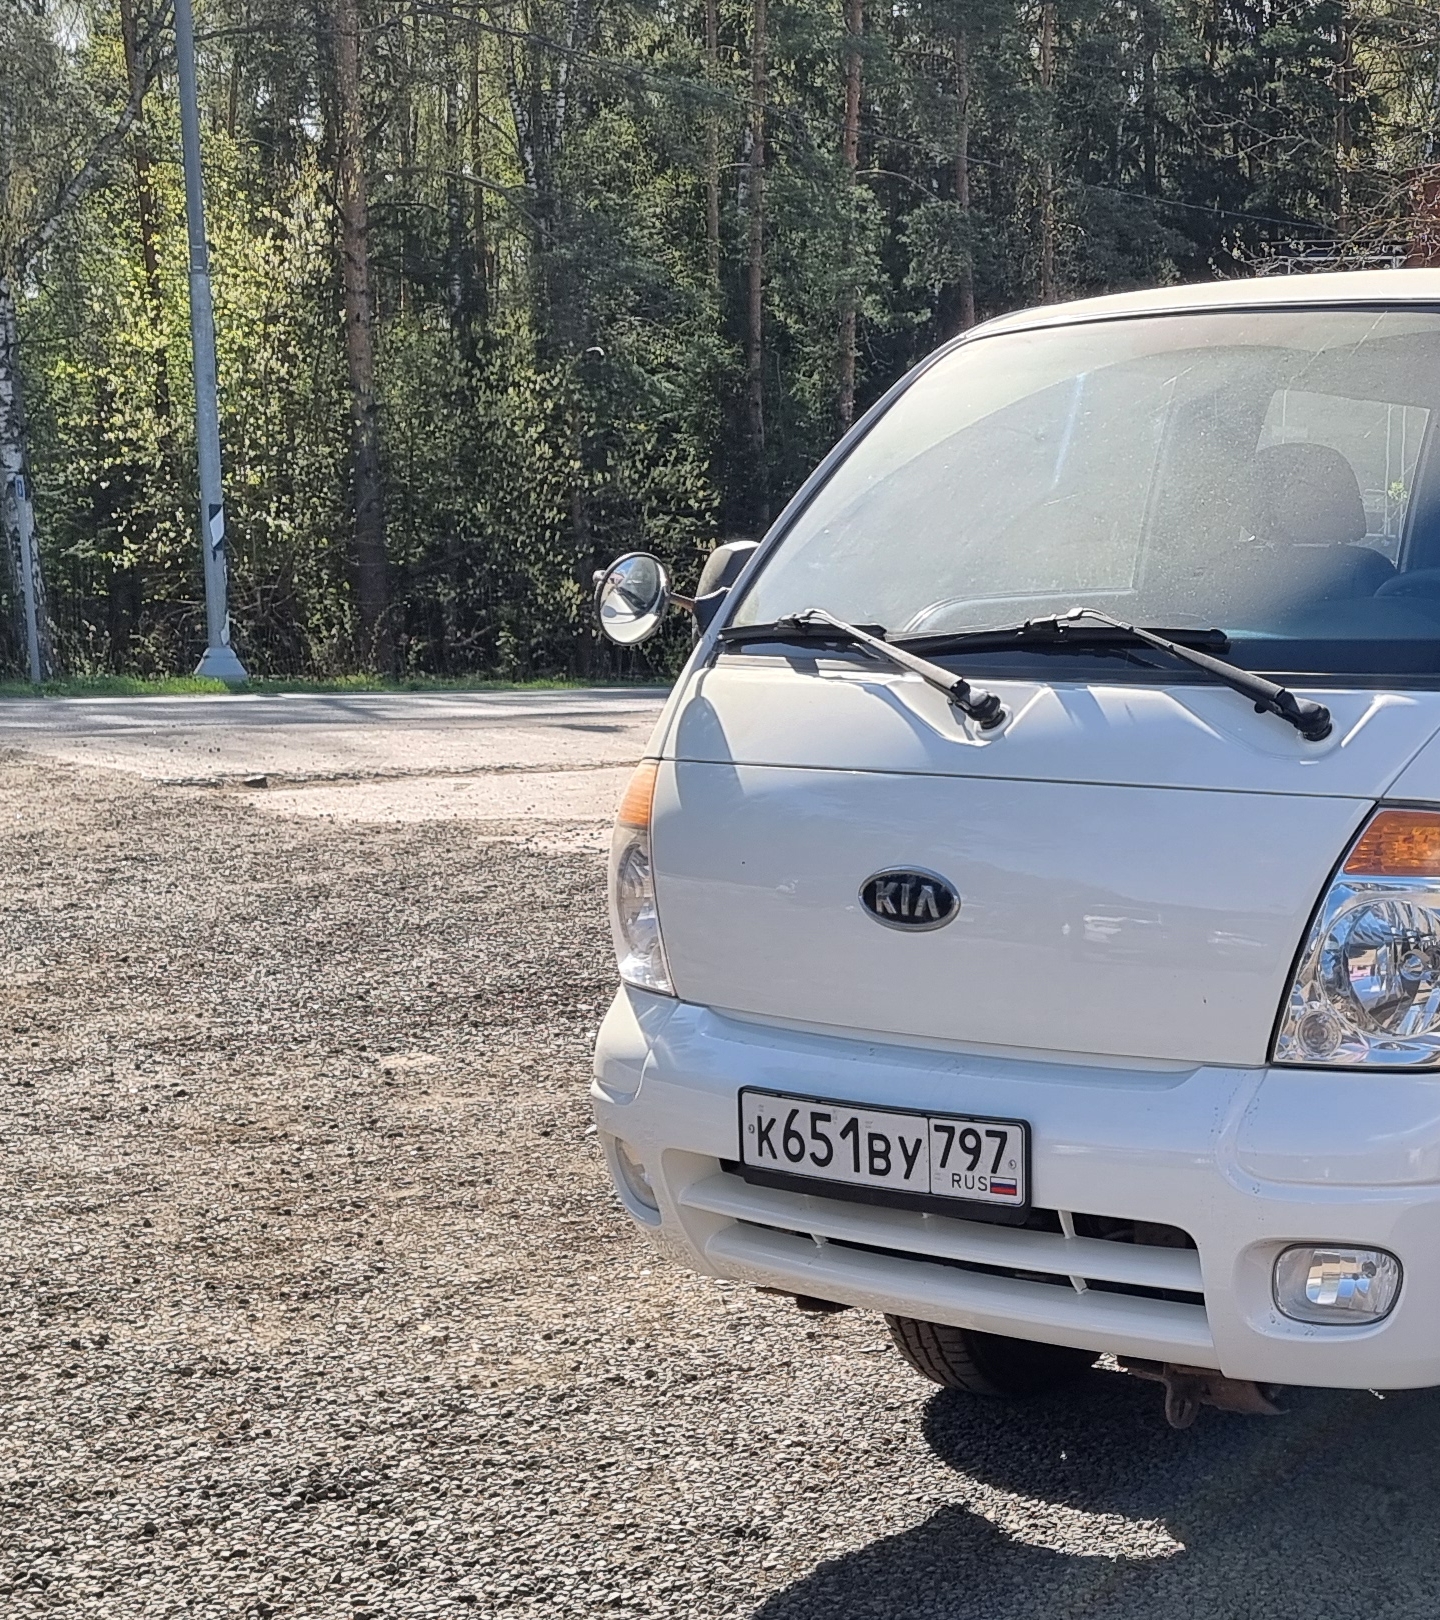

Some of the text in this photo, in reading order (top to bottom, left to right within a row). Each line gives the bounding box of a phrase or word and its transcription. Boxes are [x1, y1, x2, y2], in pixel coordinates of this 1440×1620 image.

[876, 881, 940, 918] KIA
[933, 1124, 1008, 1174] 797
[951, 1173, 988, 1192] RUS
